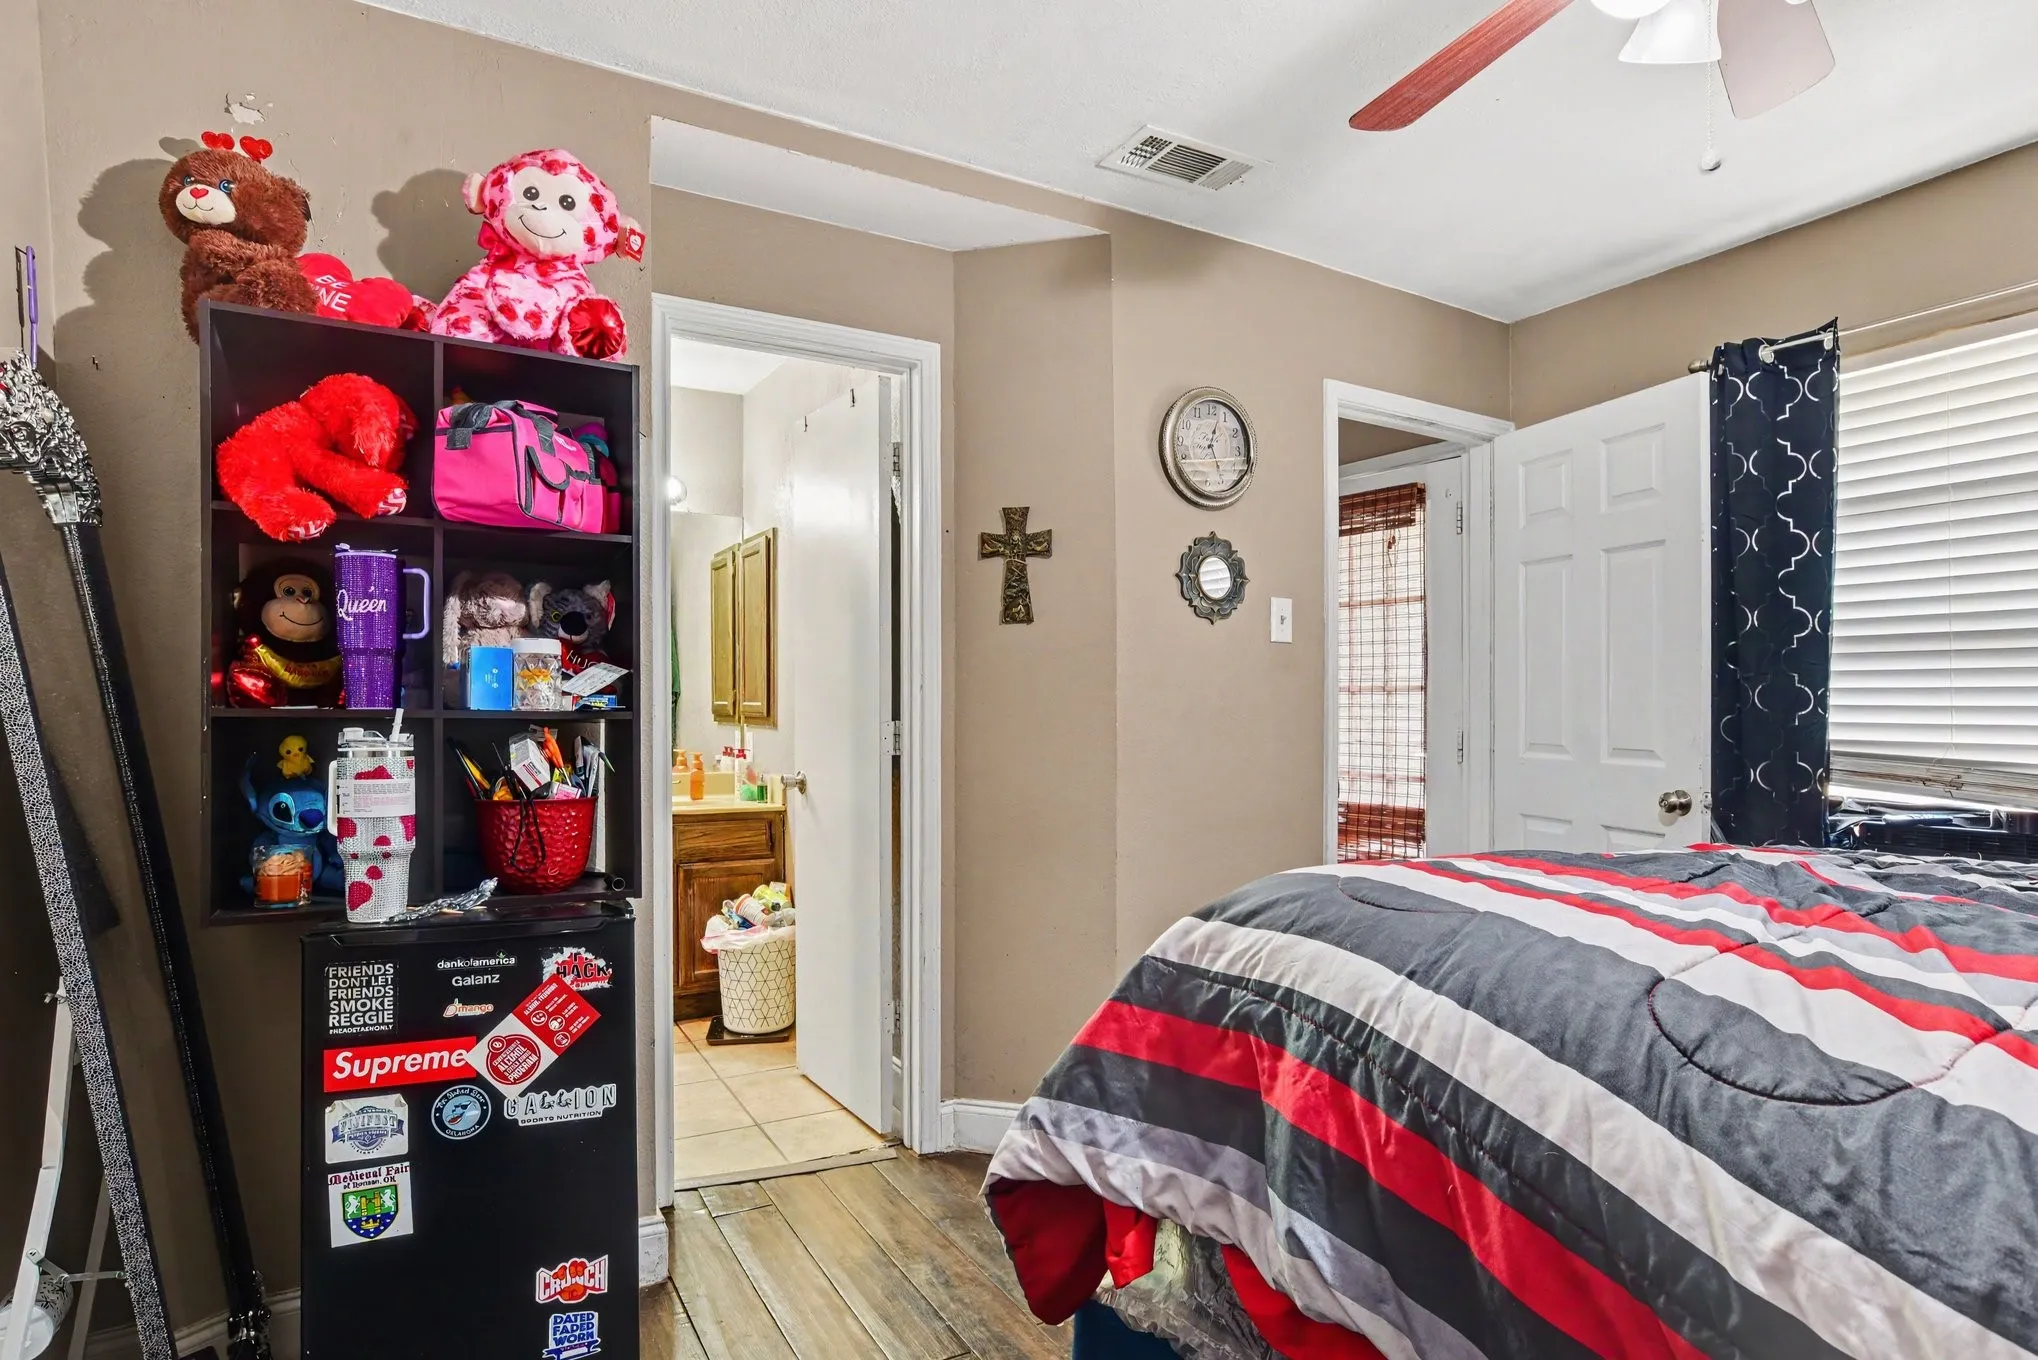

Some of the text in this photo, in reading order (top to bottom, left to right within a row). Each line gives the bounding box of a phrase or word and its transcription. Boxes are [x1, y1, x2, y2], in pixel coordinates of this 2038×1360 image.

[315, 275, 350, 289] BE
[313, 286, 351, 312] NE
[1207, 404, 1217, 416] 12
[1223, 411, 1227, 422] 1
[1181, 420, 1191, 430] 10
[1232, 428, 1239, 438] 2
[1177, 435, 1184, 446] 9
[1234, 446, 1241, 457] 3
[337, 589, 387, 621] Queen
[329, 963, 394, 978] FRIENDS
[329, 975, 394, 988] DONT LET
[452, 974, 500, 986] Galanz
[329, 985, 394, 1000] FRIENDS
[330, 997, 394, 1013] SMOKE
[329, 1010, 394, 1027] REGGIE
[333, 1049, 468, 1084] Supreme
[508, 1053, 539, 1082] PROGRAM
[328, 1163, 410, 1186] Medieval Fair
[539, 1259, 605, 1300] CRUNCH
[553, 1313, 594, 1325] DATED
[553, 1322, 594, 1336] FADED
[553, 1331, 594, 1347] WORN
